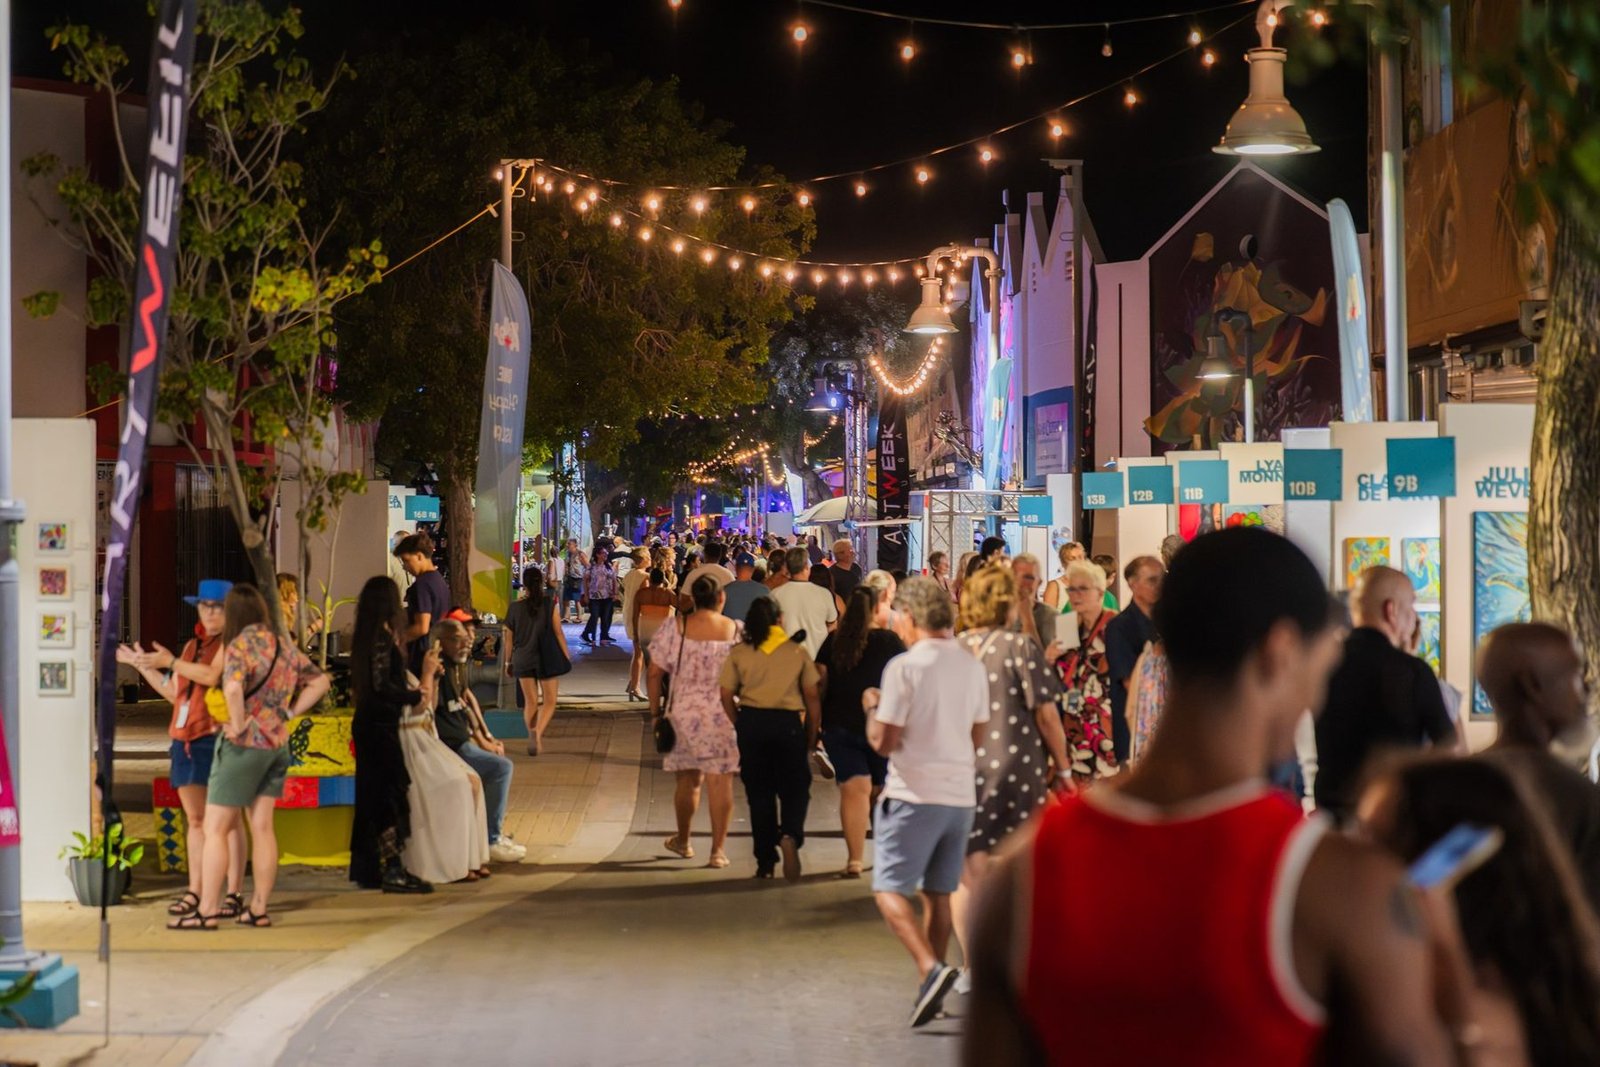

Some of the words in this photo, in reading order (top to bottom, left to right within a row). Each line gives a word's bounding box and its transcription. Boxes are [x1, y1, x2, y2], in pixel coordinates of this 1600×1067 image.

[1288, 481, 1316, 496] 10B
[1394, 474, 1418, 493] 9B
[1086, 494, 1106, 505] 13B
[1132, 489, 1153, 502] 12B
[1184, 487, 1204, 500] 11B
[1021, 513, 1038, 524] 14B
